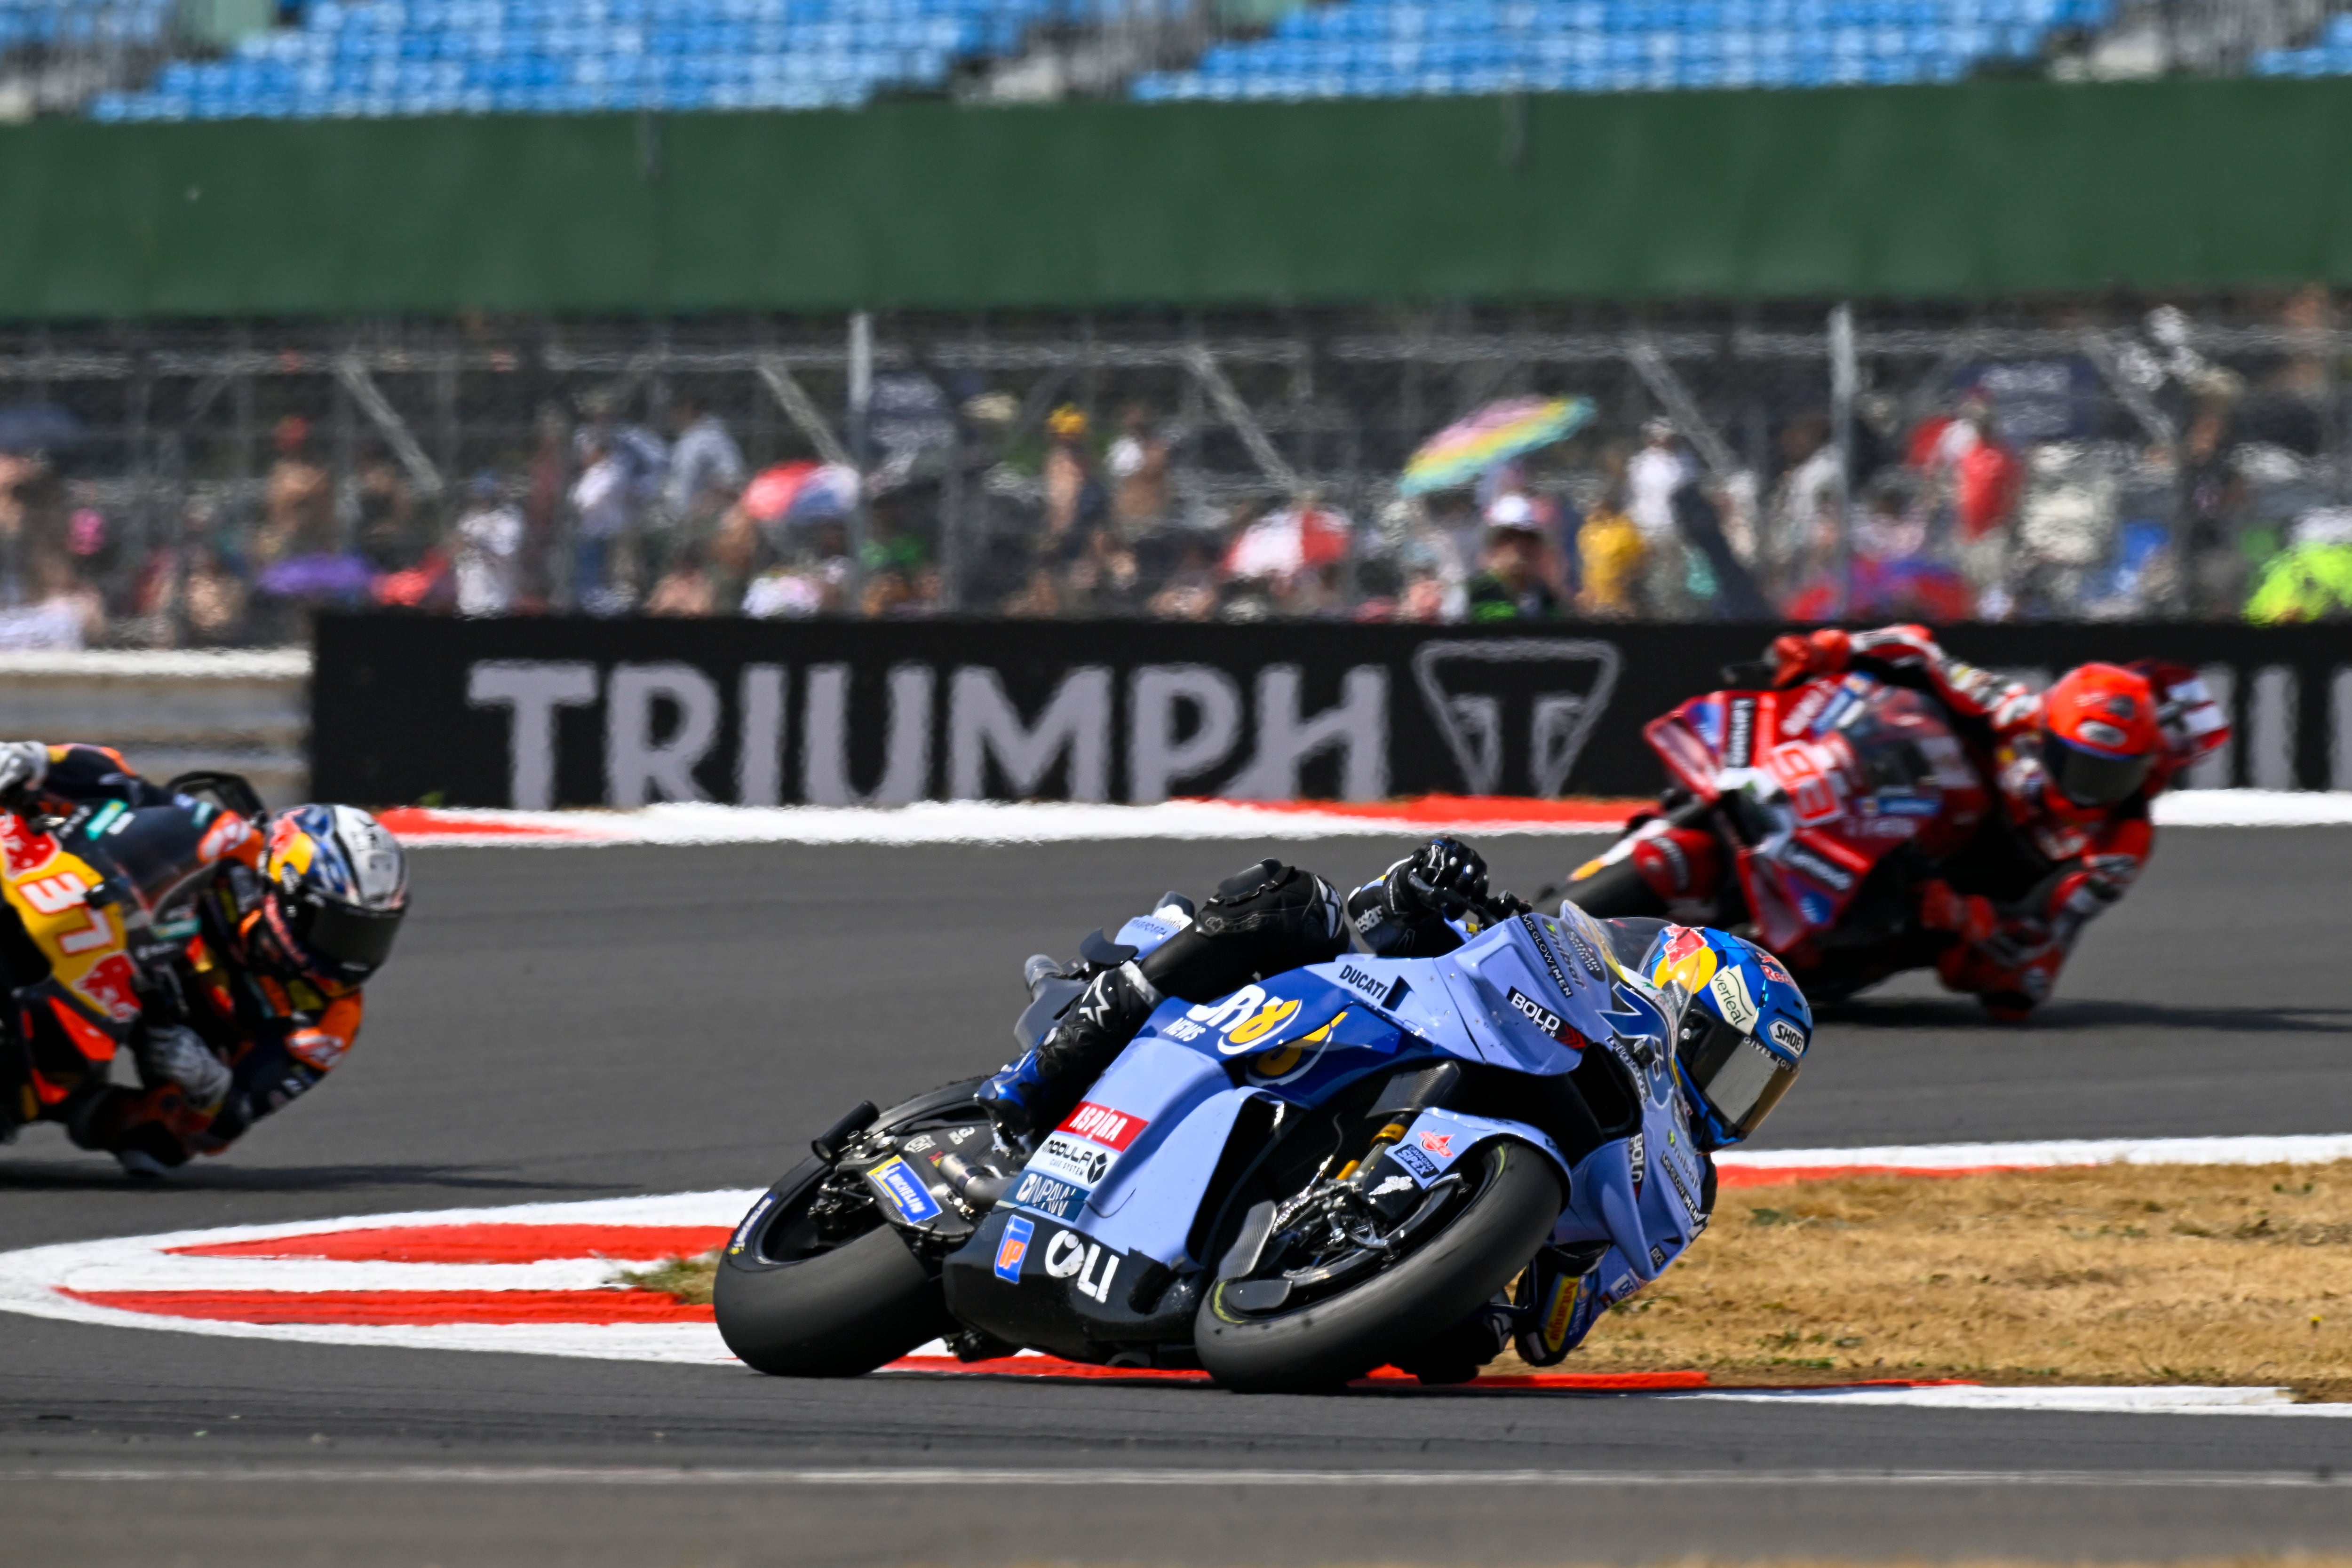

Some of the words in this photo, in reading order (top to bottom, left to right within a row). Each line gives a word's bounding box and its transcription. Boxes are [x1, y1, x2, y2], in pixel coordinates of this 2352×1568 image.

[467, 662, 1391, 808] TRIUMPH
[18, 872, 114, 955] 37
[1339, 964, 1389, 1000] DUCATI
[1552, 969, 1572, 997] MEN
[1511, 992, 1560, 1031] BOLD
[1162, 1017, 1206, 1042] NEWS
[1743, 1037, 1771, 1058] GIVES
[1042, 1140, 1093, 1166] MODULA
[1398, 1149, 1426, 1174] SIPEX
[1408, 1146, 1434, 1171] CAVAGNA
[887, 1171, 925, 1214] MICHELIN
[998, 1238, 1026, 1269] IP
